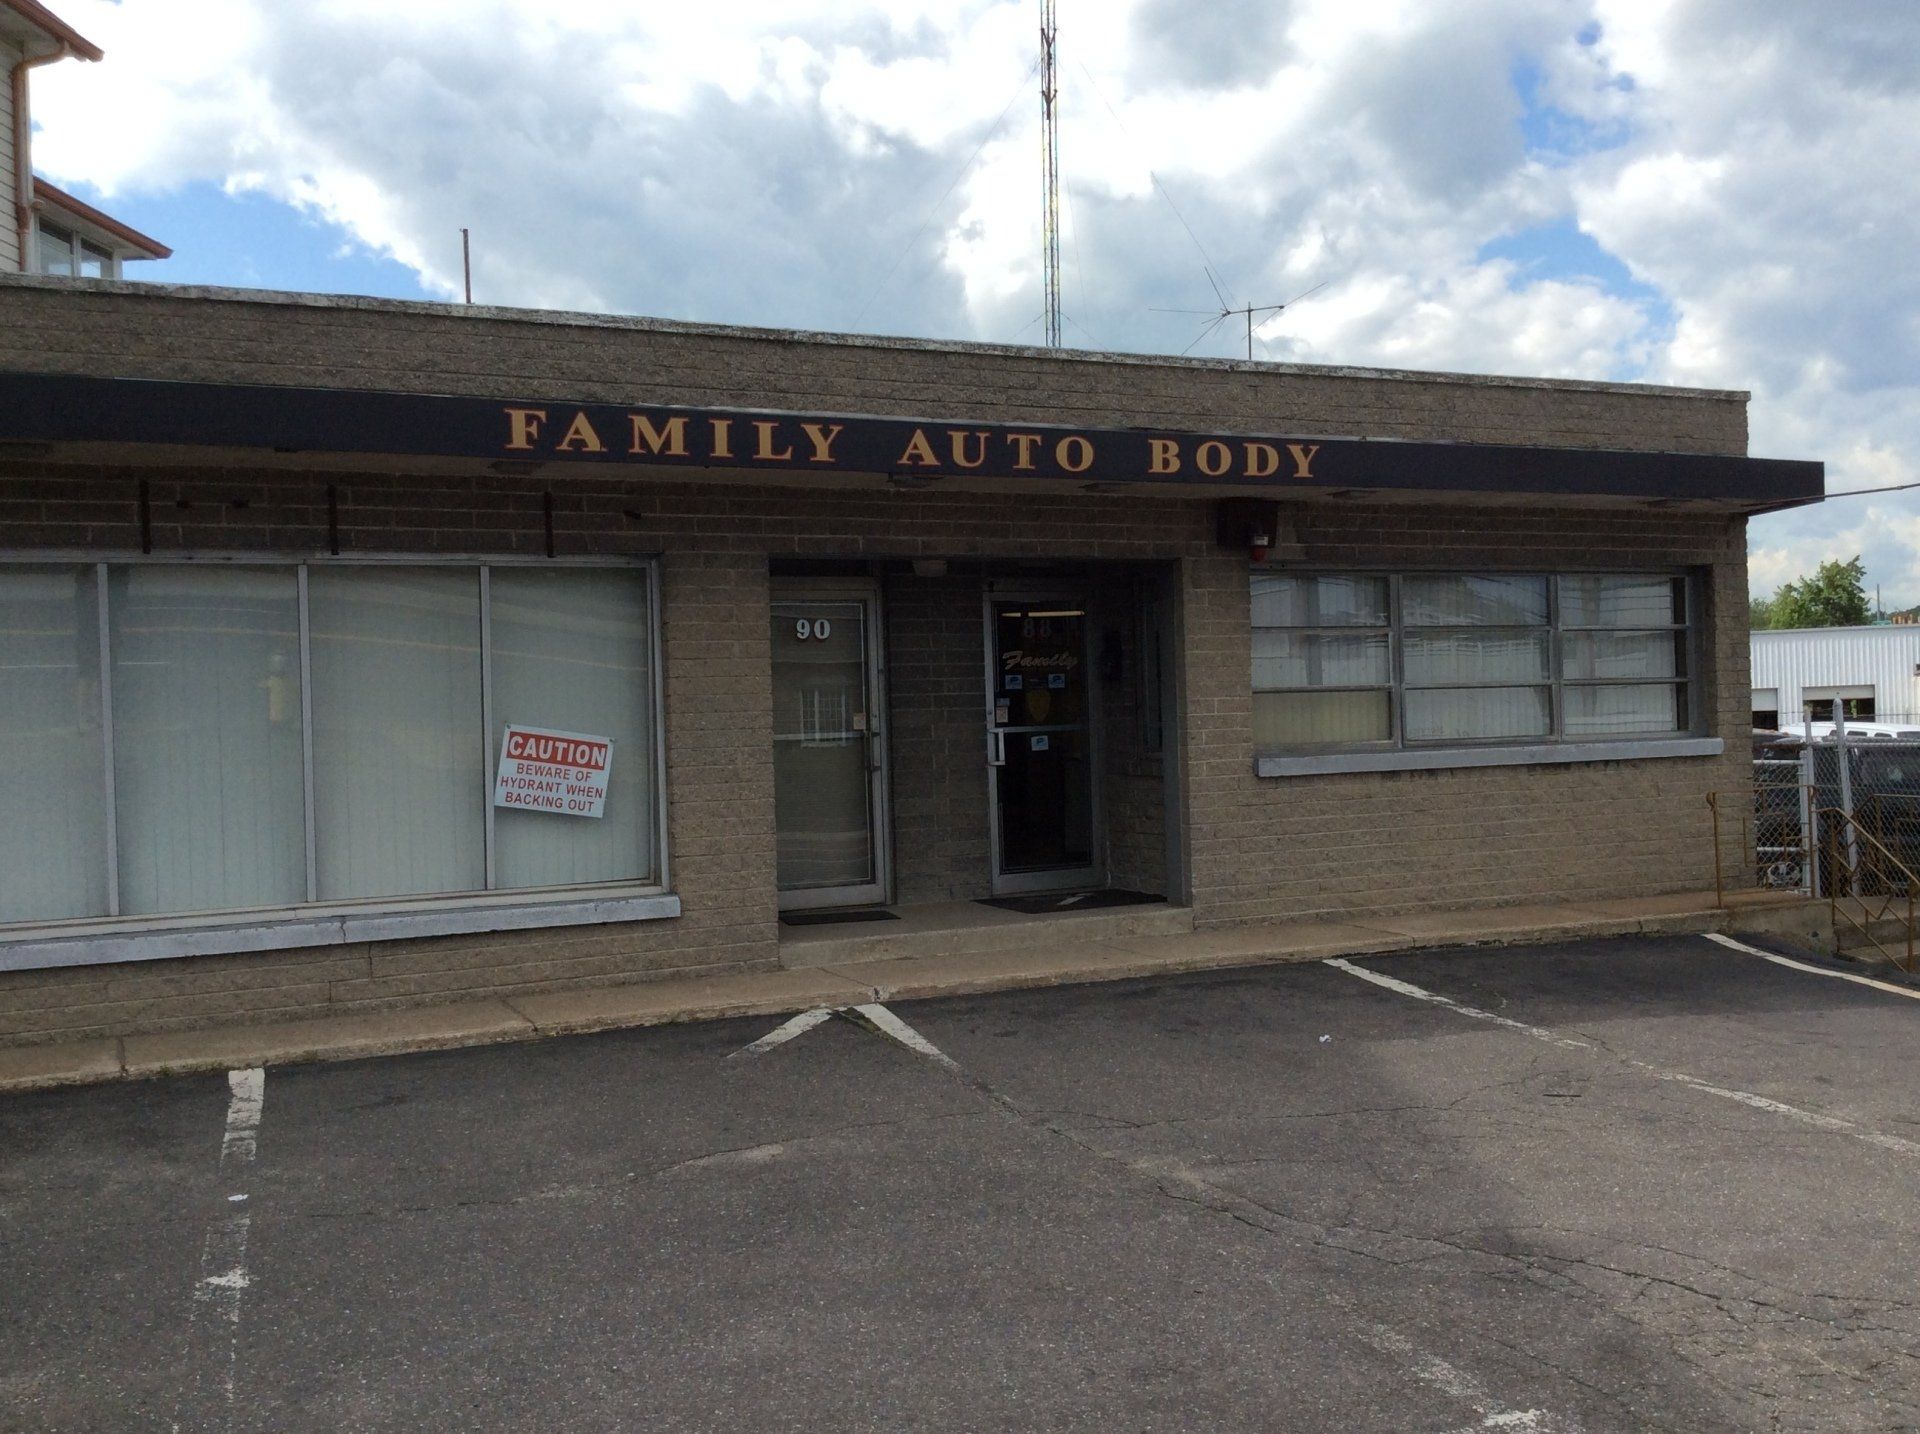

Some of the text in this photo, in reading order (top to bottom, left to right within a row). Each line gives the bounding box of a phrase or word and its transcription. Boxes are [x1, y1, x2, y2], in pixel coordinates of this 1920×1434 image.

[503, 408, 1320, 478] FAMILY AUTO BODY
[796, 619, 831, 640] 90
[509, 735, 606, 767] CAUTION
[516, 762, 593, 782] BEWARE OF
[500, 776, 604, 798] HYDRANT WHEN
[505, 791, 595, 812] BACKING OUT
